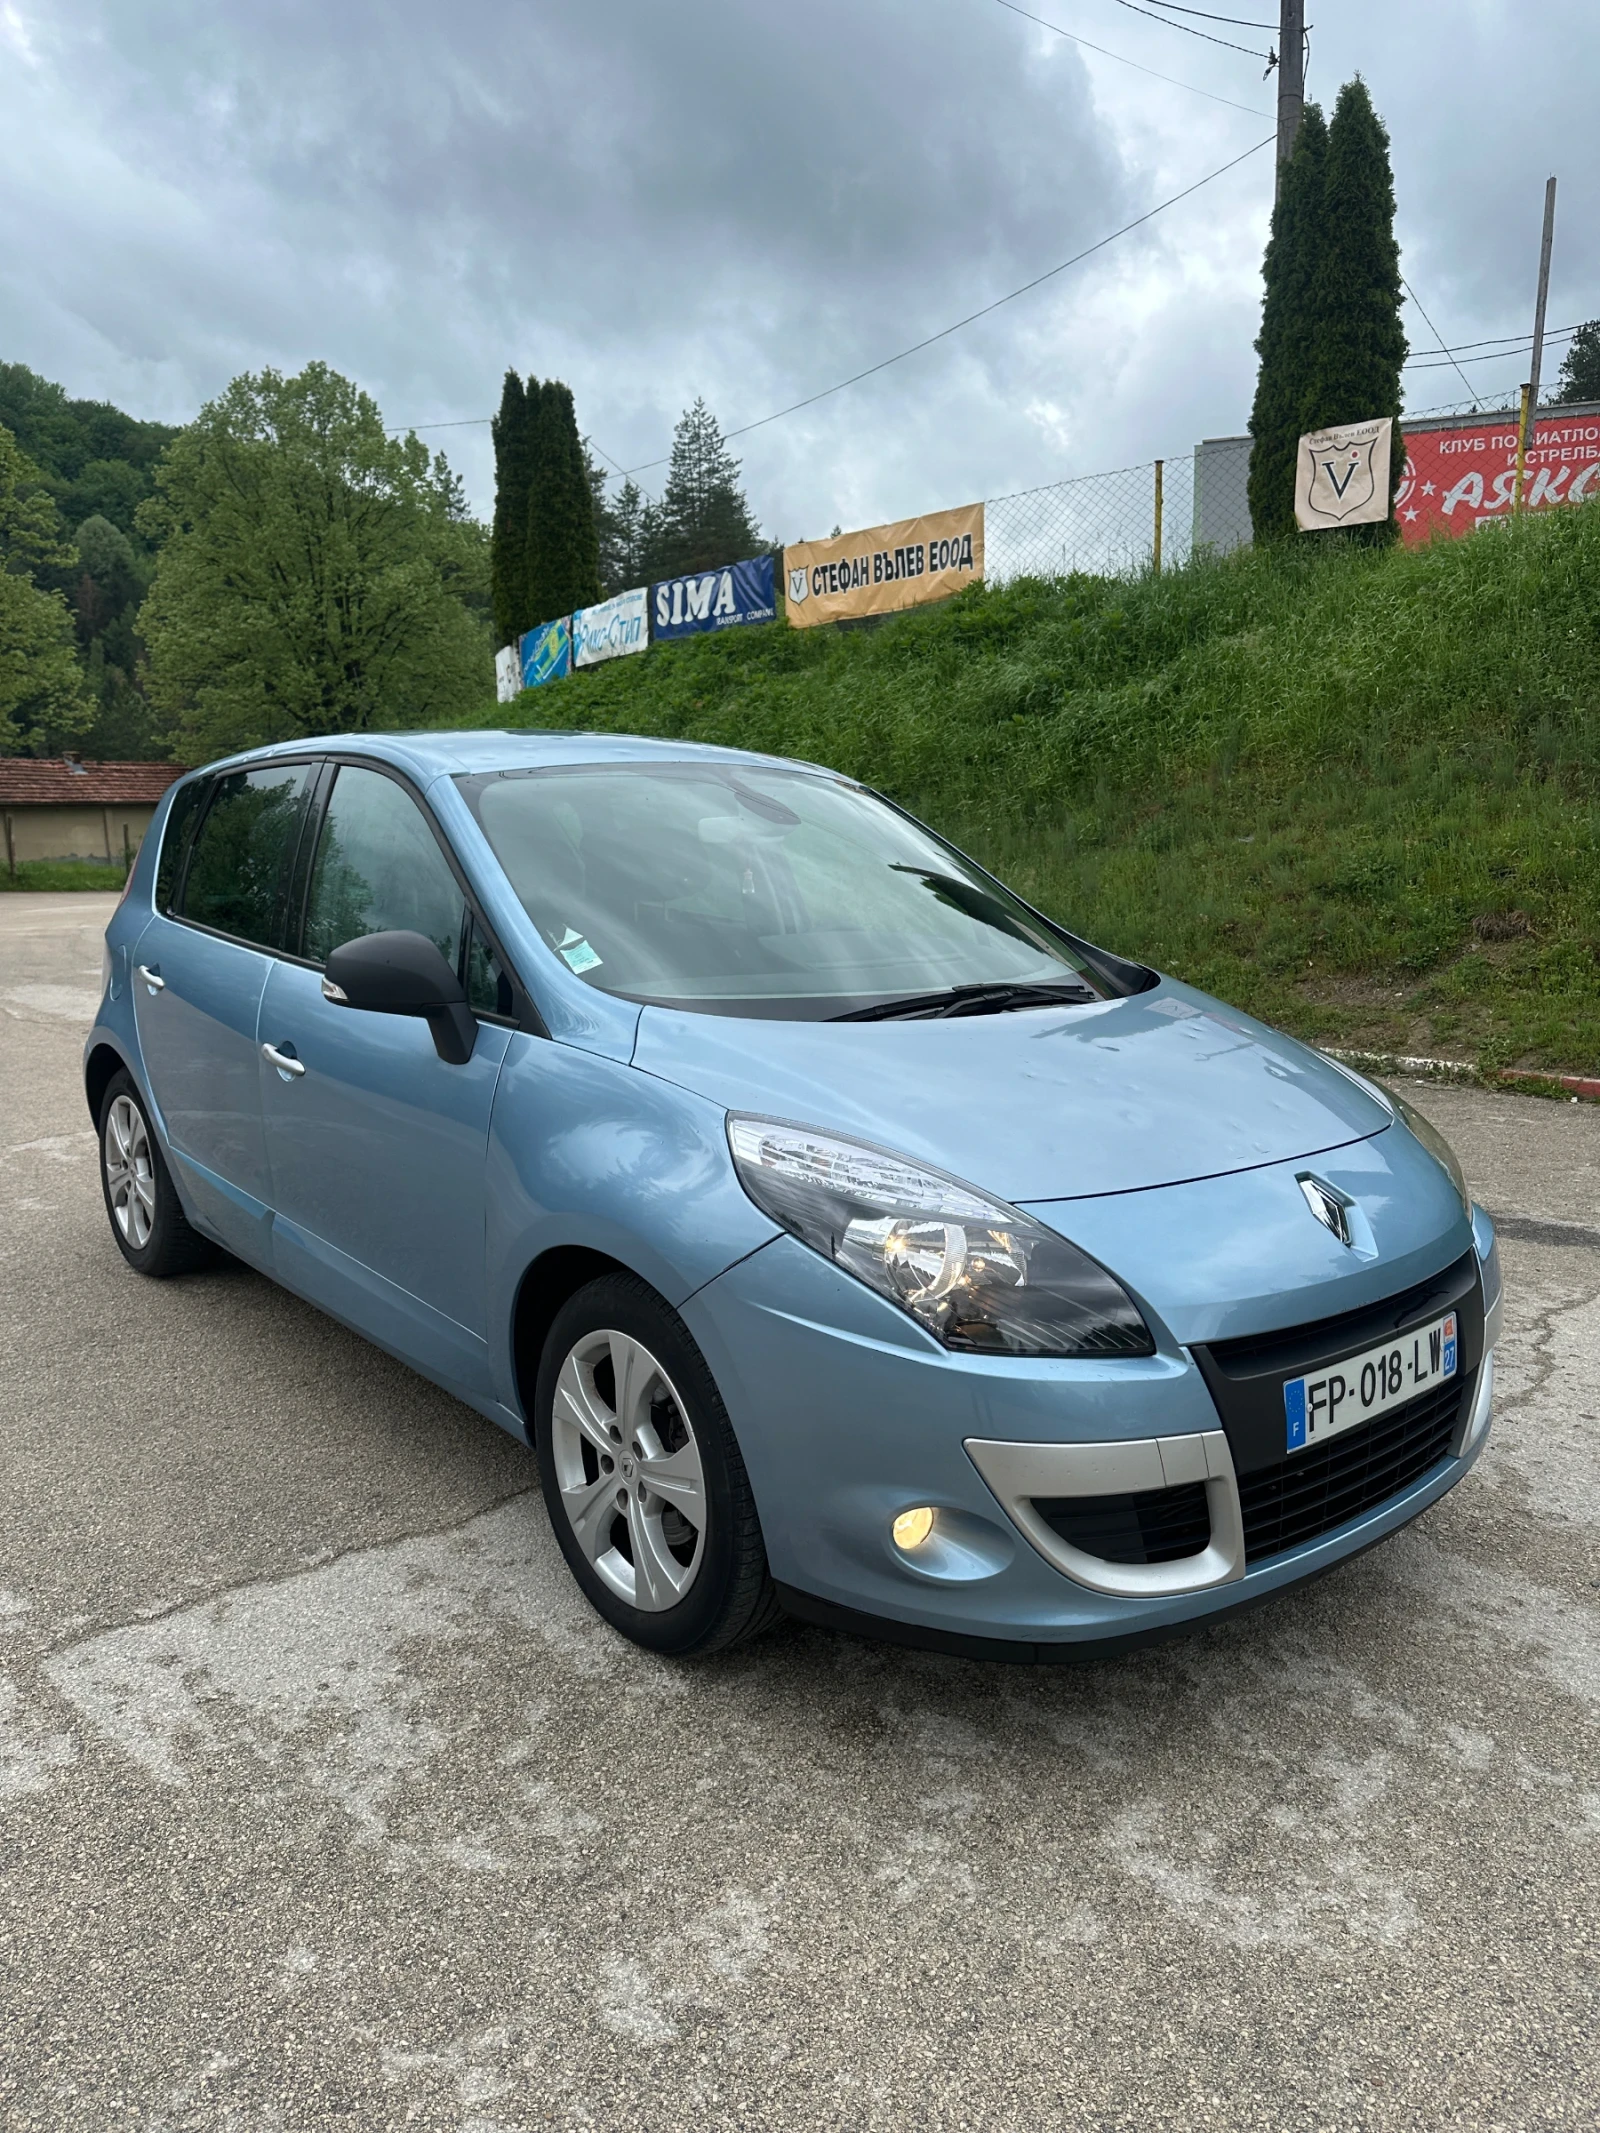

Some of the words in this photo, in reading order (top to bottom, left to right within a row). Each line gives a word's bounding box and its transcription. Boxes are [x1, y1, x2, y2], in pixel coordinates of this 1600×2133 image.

[1439, 437, 1486, 454] КЛУБ
[1491, 434, 1518, 450] ПО
[1532, 427, 1599, 446] ИАТЛО
[1524, 445, 1600, 464] СТРЕЛБ
[1321, 461, 1360, 499] V
[812, 556, 870, 596] СТЕФАН
[874, 544, 924, 584] ВЪЛЕВ
[929, 533, 974, 572] ЕООД
[656, 570, 736, 627] SIMA
[1444, 1346, 1455, 1371] 27
[1308, 1327, 1442, 1433] FP-018-LW
[1292, 1421, 1300, 1437] F
